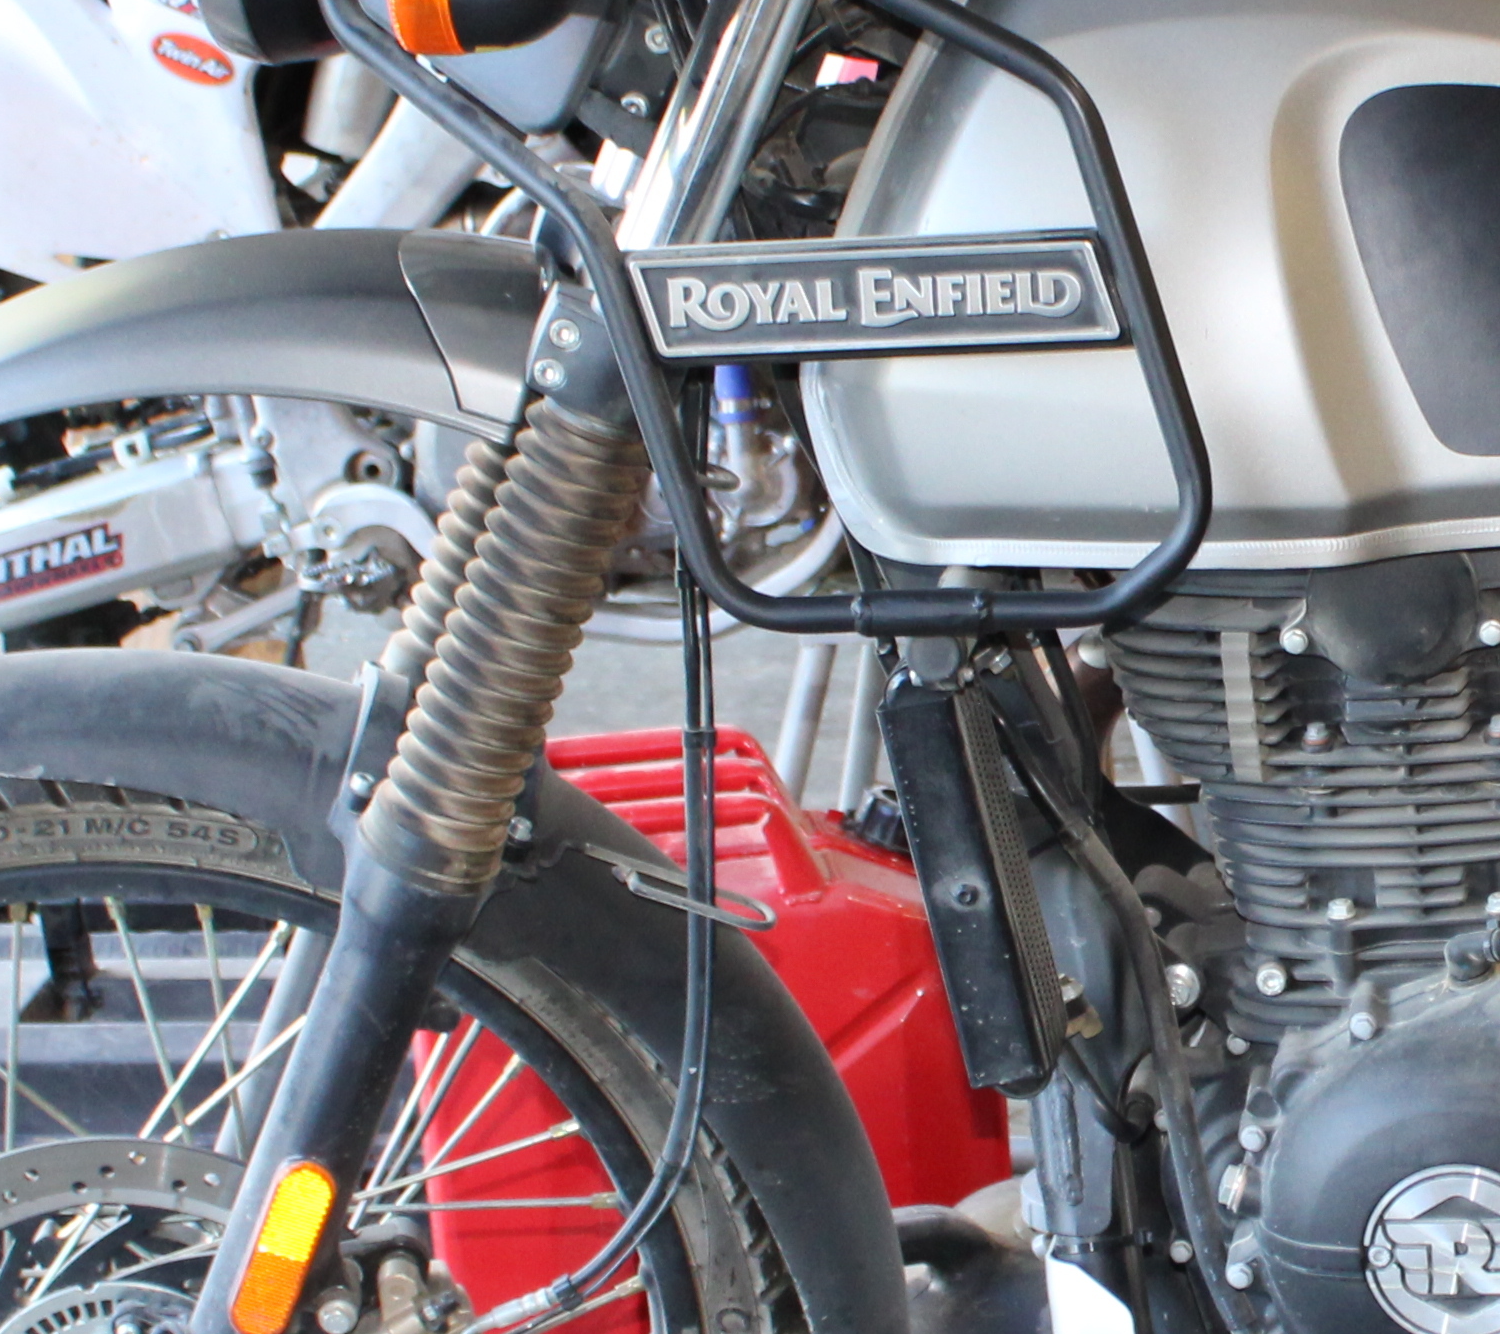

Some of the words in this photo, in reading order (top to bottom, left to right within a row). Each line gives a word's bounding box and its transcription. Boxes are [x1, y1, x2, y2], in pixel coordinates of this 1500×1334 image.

[667, 277, 848, 331] ROYAL
[859, 267, 1082, 329] ENFIELD
[166, 820, 241, 848] 54S
